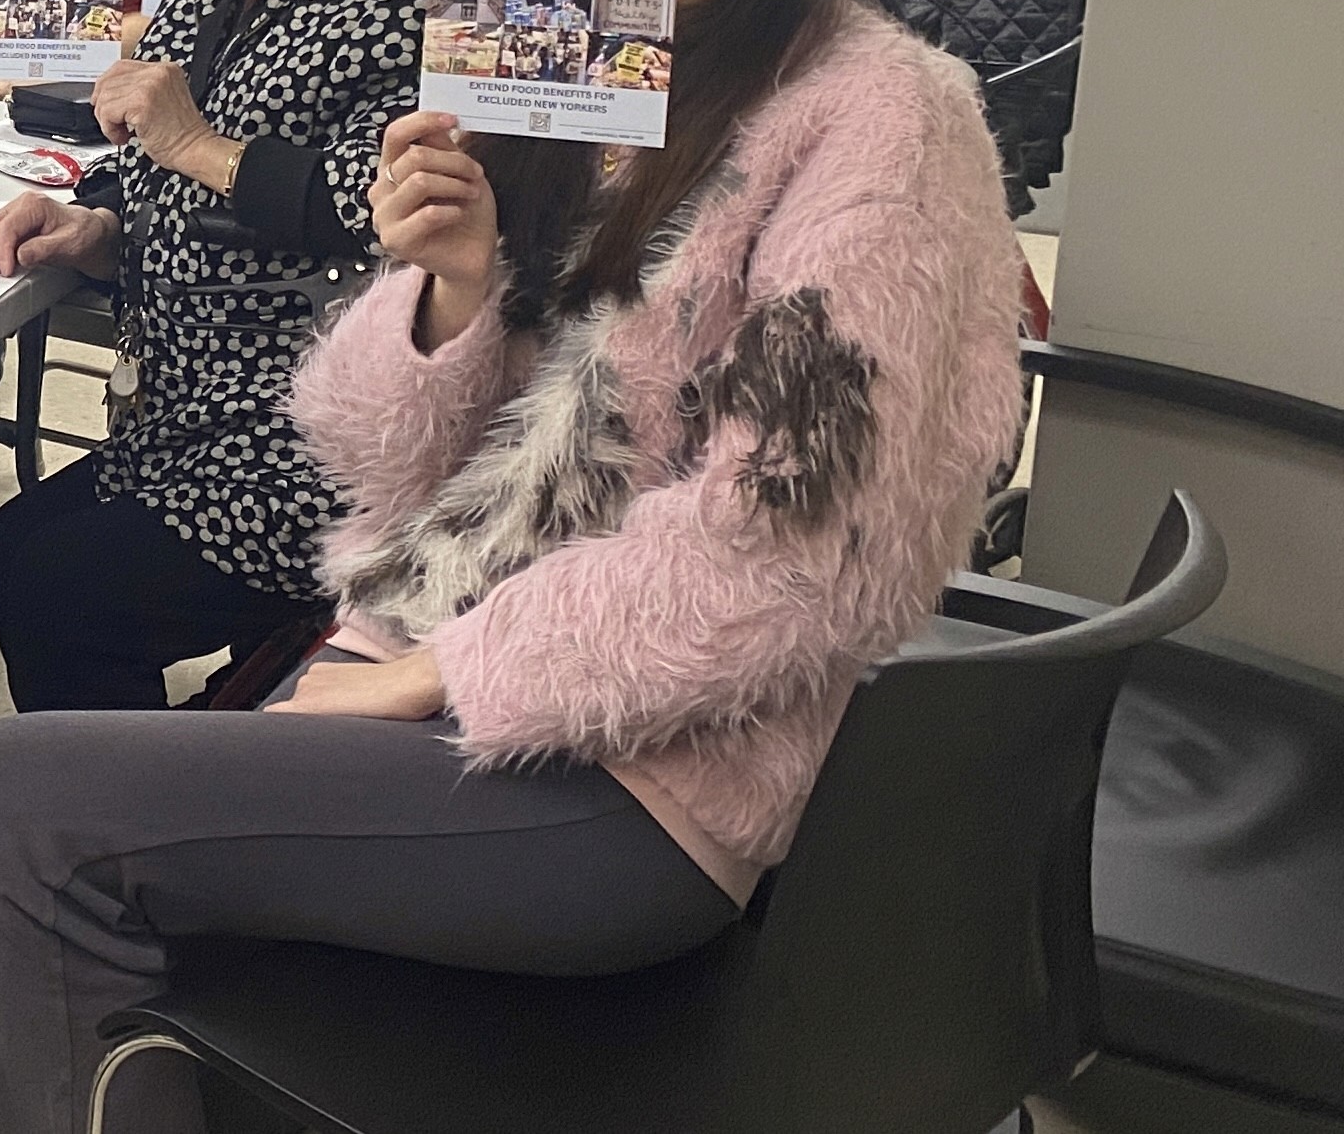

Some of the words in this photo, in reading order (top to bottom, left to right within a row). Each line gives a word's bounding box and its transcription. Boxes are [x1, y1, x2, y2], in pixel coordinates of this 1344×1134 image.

[15, 42, 34, 50] FOOD
[35, 42, 70, 51] BENEFITS
[71, 43, 87, 51] FOR
[469, 81, 509, 93] EXTEND
[511, 83, 541, 95] FOOD
[543, 86, 593, 100] BENEFITS
[594, 90, 616, 101] FOR
[477, 95, 532, 108] EXCLUDED
[534, 99, 559, 110] NEW
[560, 101, 608, 114] YORKERS
